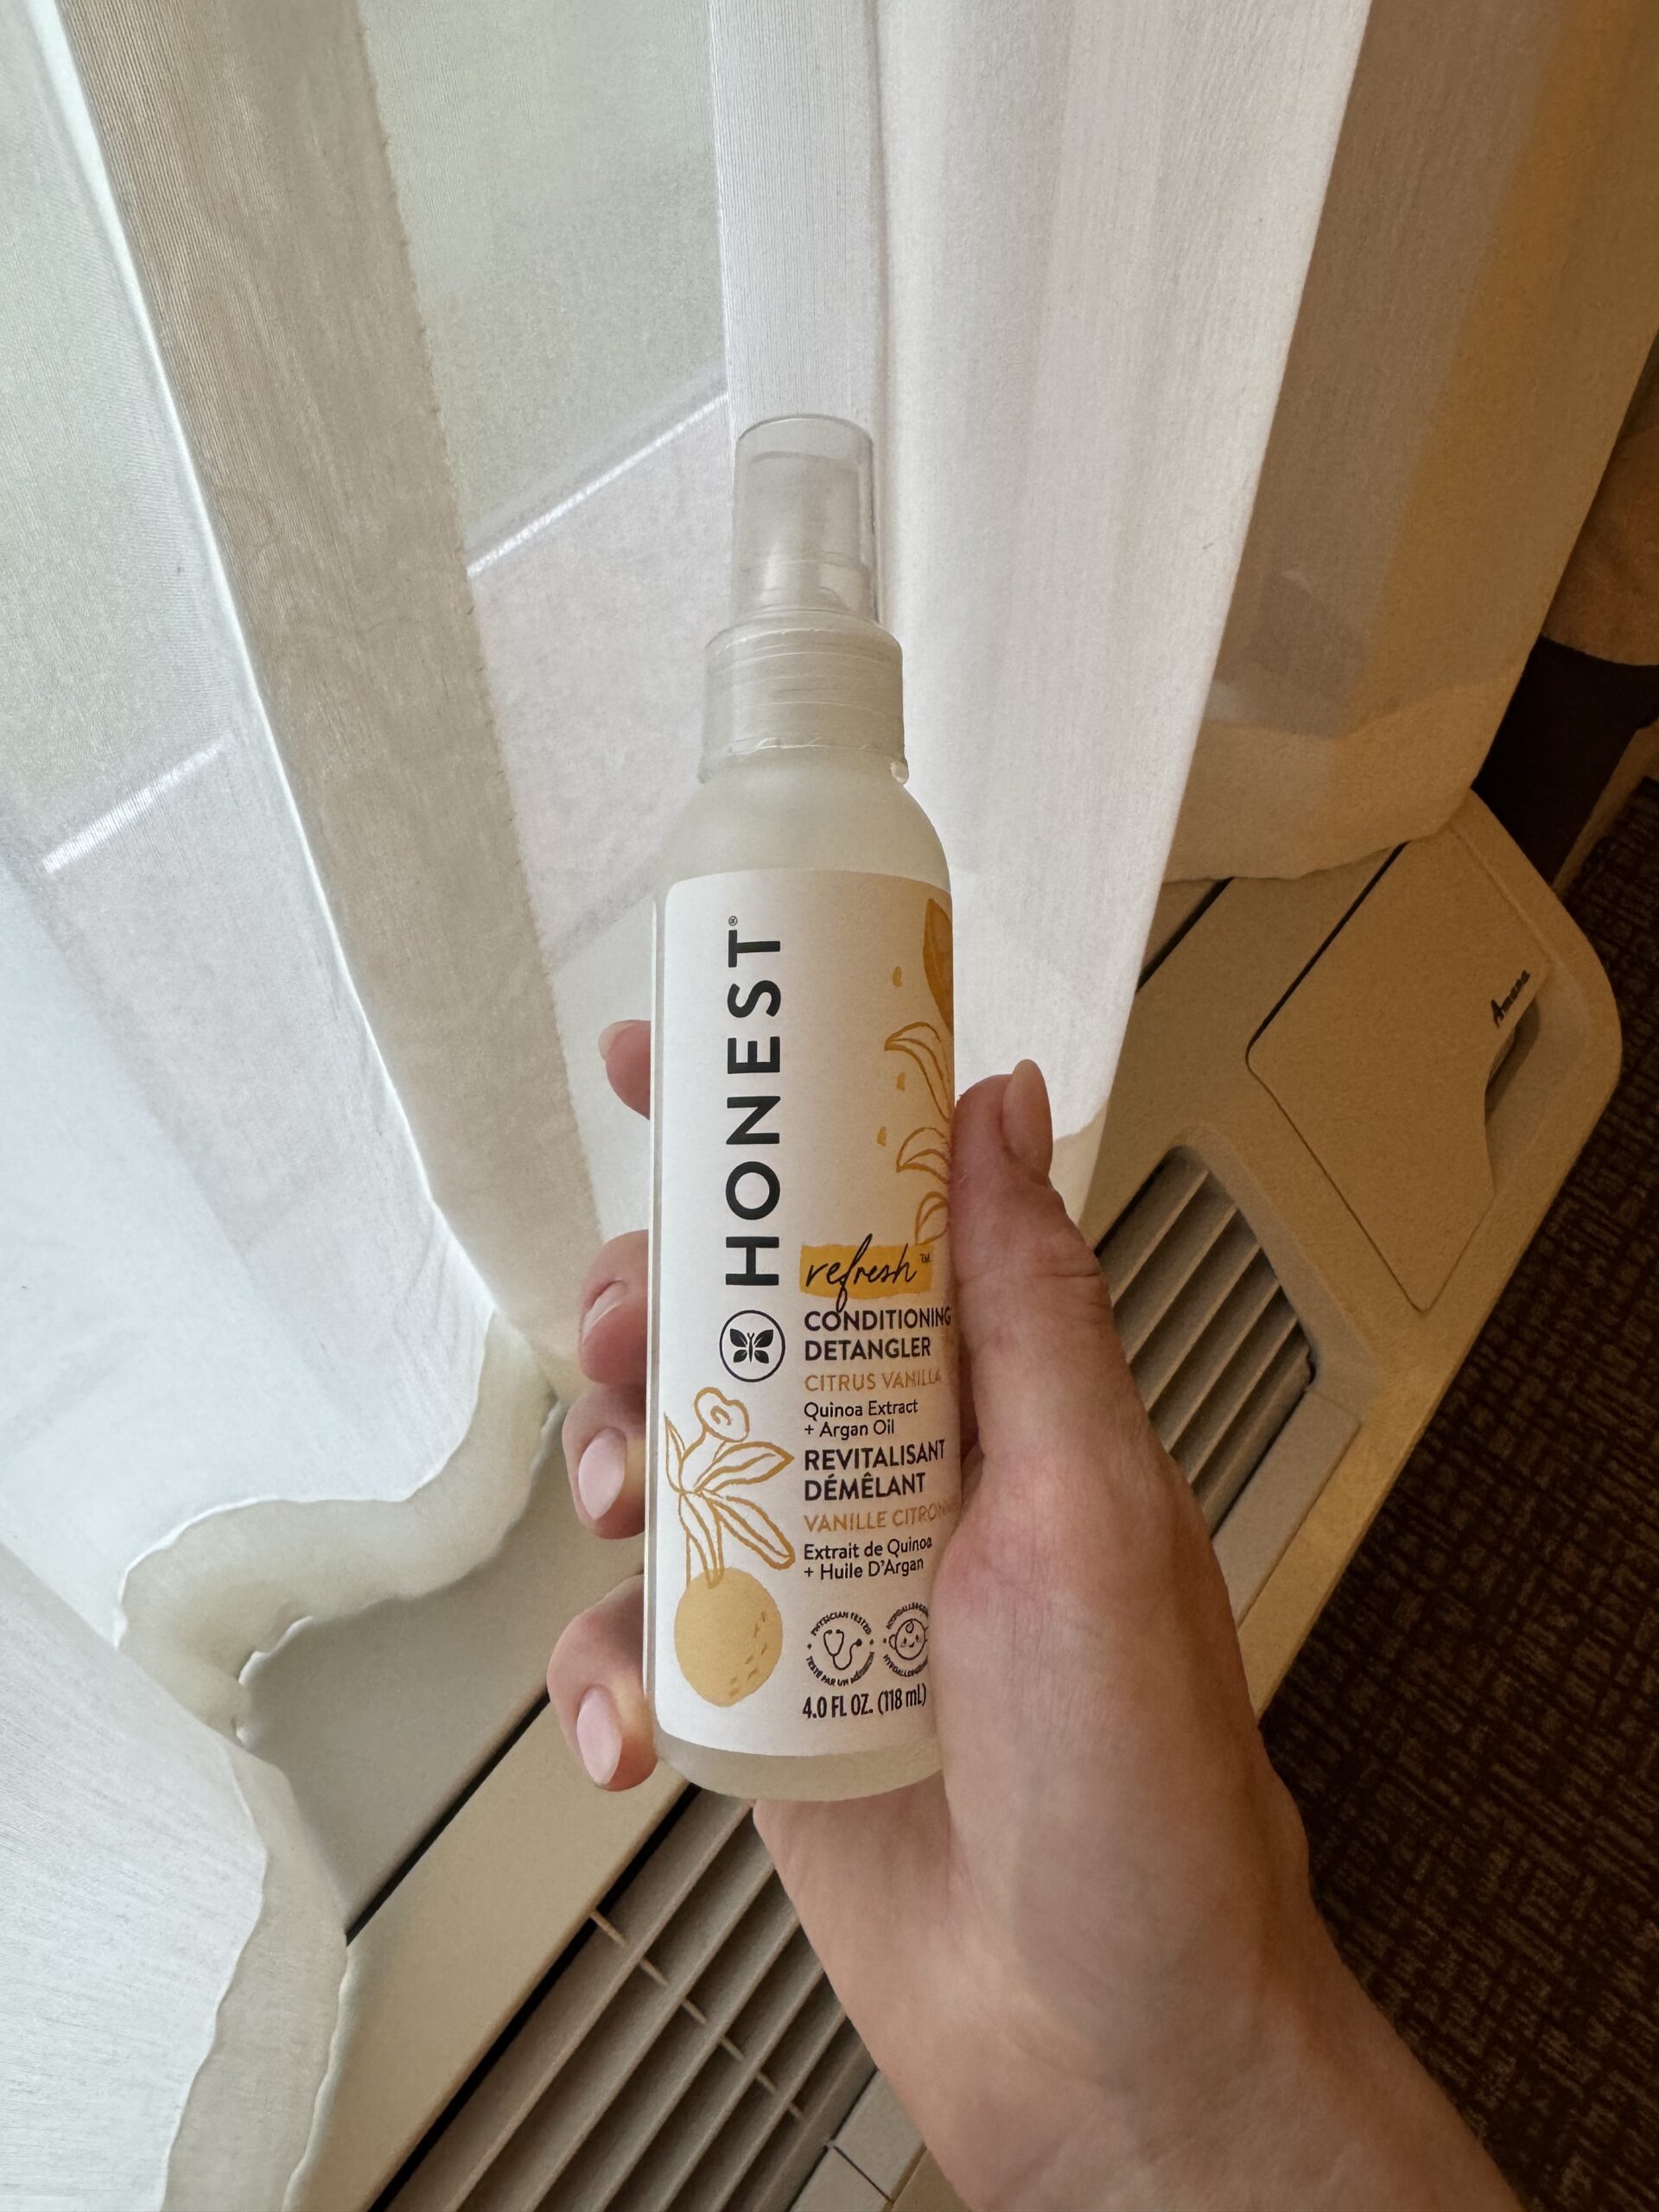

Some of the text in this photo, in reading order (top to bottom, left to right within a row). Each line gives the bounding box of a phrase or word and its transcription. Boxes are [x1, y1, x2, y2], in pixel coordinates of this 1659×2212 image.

[804, 1306, 951, 1332] CONDITIONING
[804, 1337, 931, 1361] DETANGLER
[804, 1369, 942, 1392] CITRUS VANILLA
[804, 1399, 918, 1421] Quinoa Extract
[819, 1421, 868, 1440] Argan
[874, 1419, 894, 1435] Oil
[804, 1439, 945, 1471] REVITALISANT
[804, 1471, 926, 1502] DÉMÊLANT
[804, 1510, 887, 1533] VANILLE
[804, 1536, 932, 1560] Extrait de Quinoa
[820, 1562, 863, 1580] Huile
[868, 1558, 924, 1577] D'Argan
[803, 1696, 827, 1719] 4.0
[831, 1695, 847, 1718] FL
[850, 1694, 874, 1716] OZ.
[878, 1688, 902, 1715] (118
